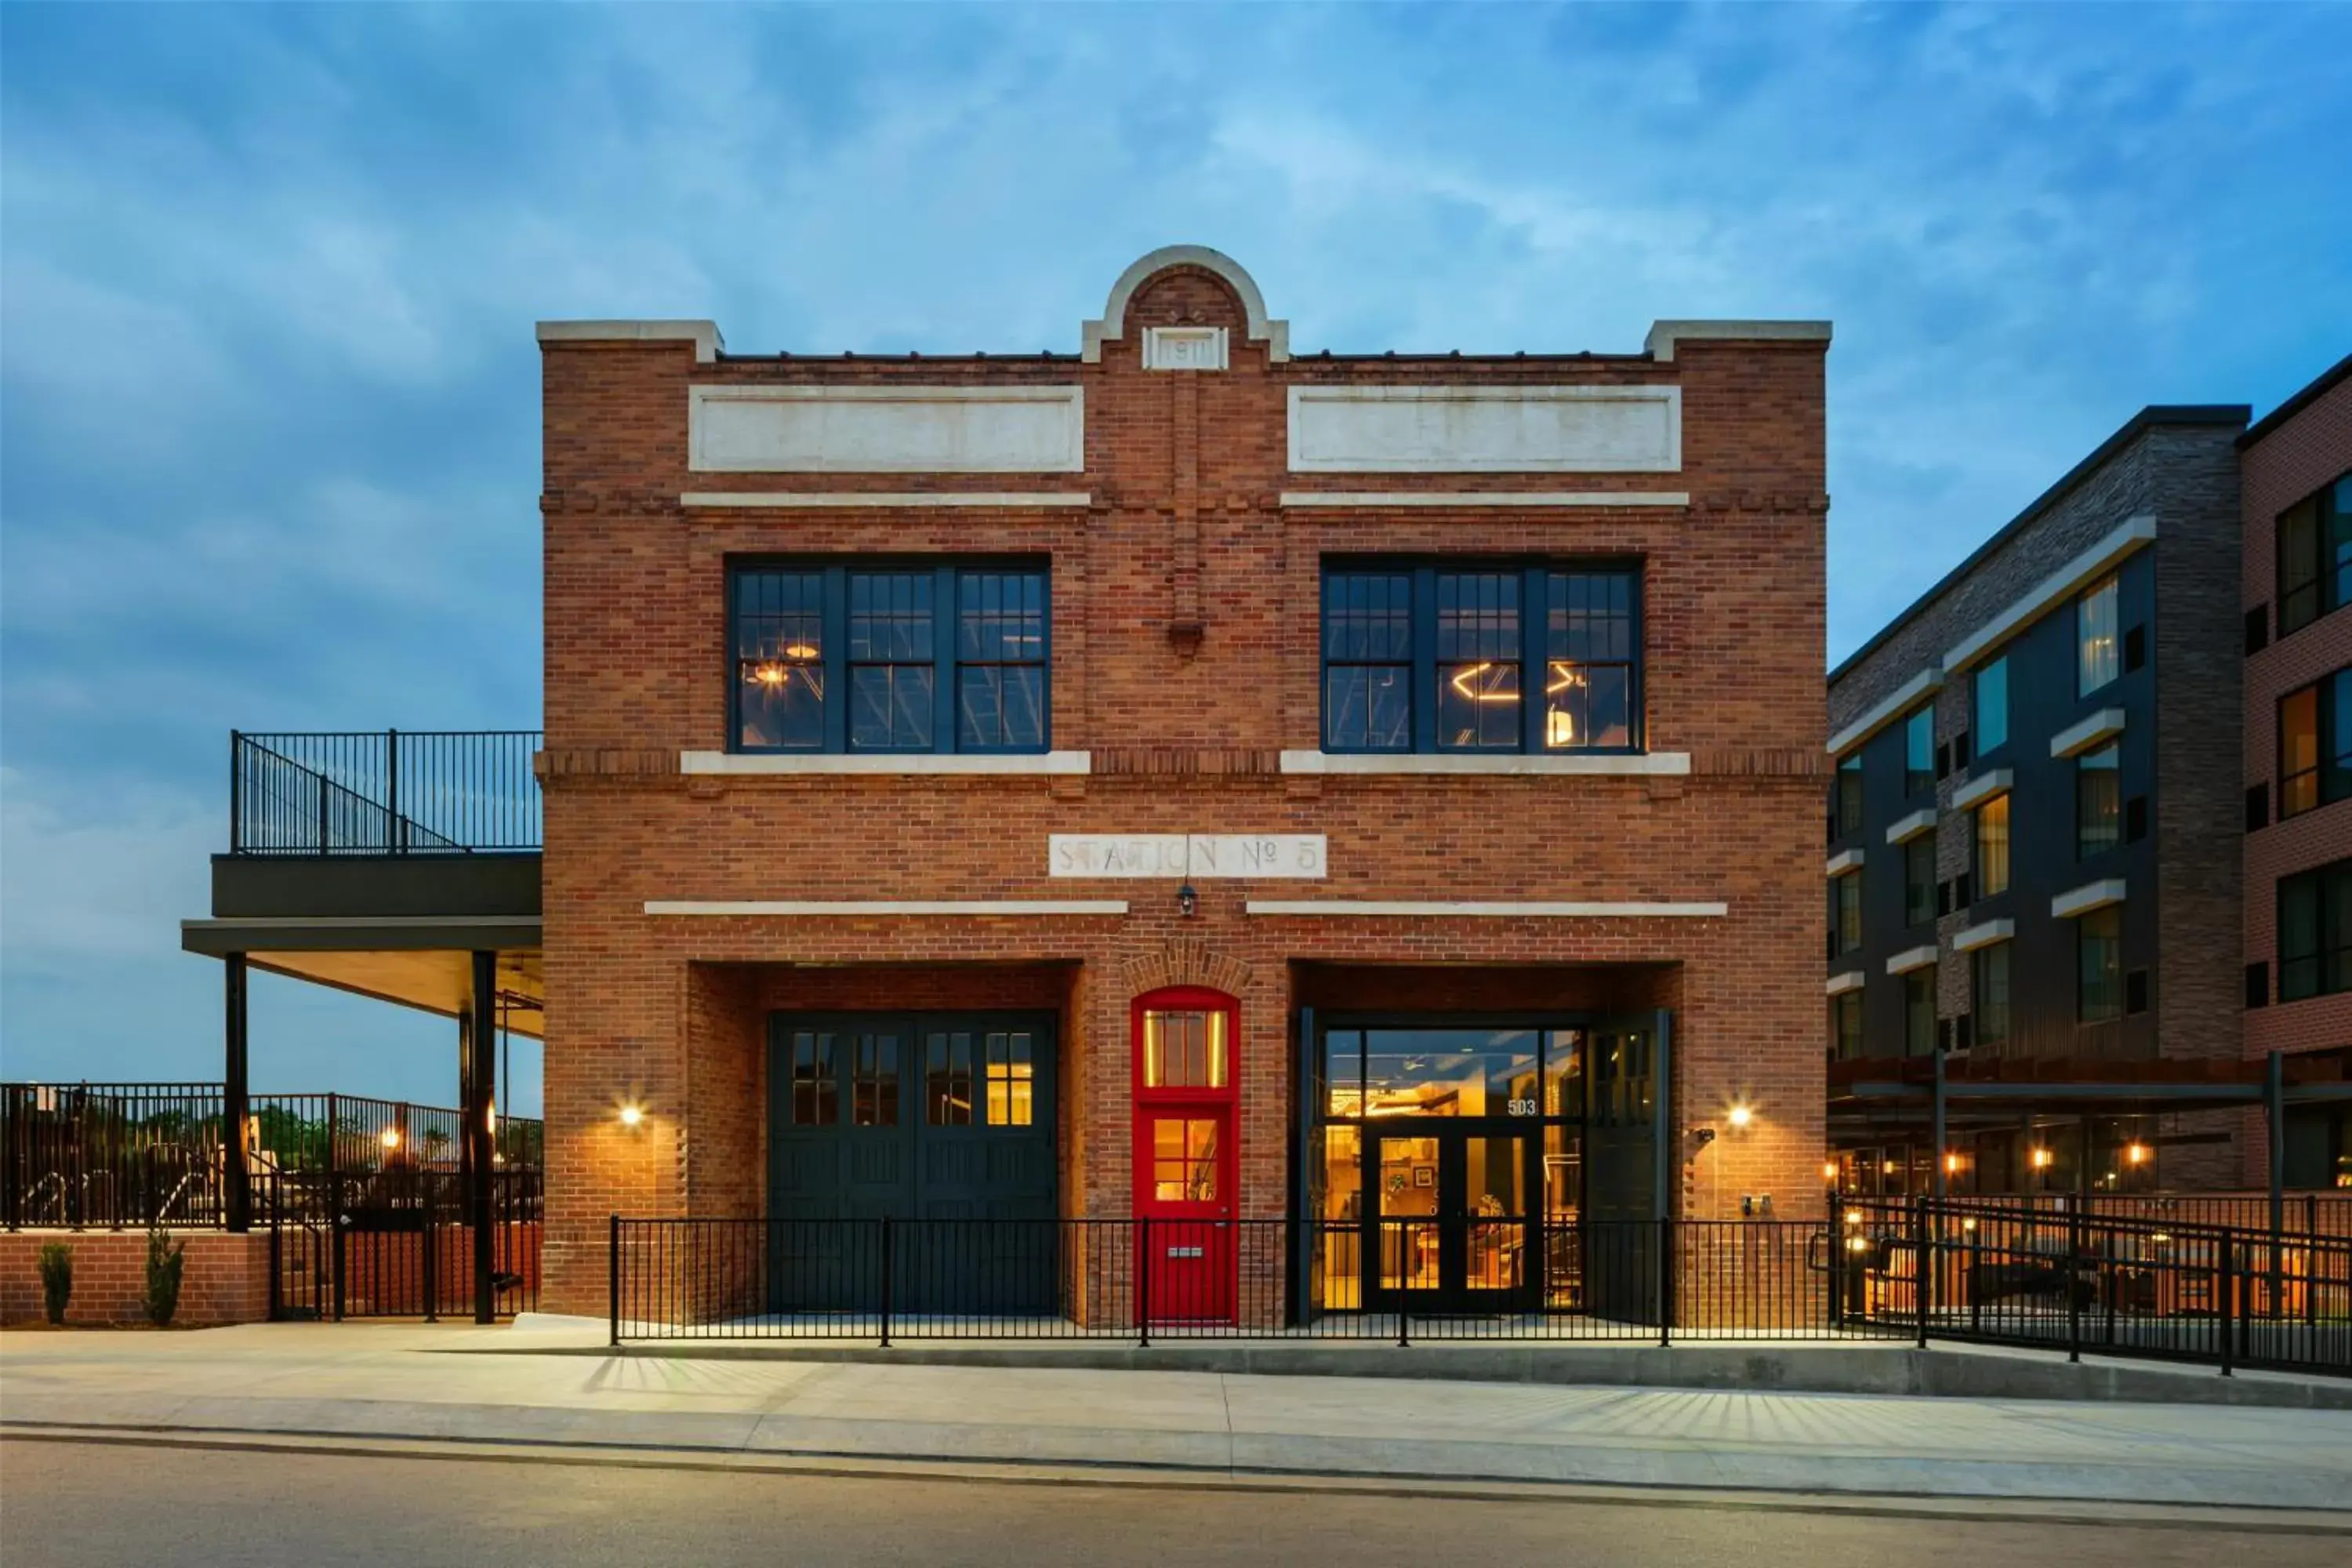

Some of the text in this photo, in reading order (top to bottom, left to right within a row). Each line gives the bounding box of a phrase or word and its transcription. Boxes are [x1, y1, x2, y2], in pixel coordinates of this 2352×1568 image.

[1058, 840, 1217, 870] STATION
[1298, 840, 1317, 869] 5
[1508, 1099, 1536, 1116] 503
